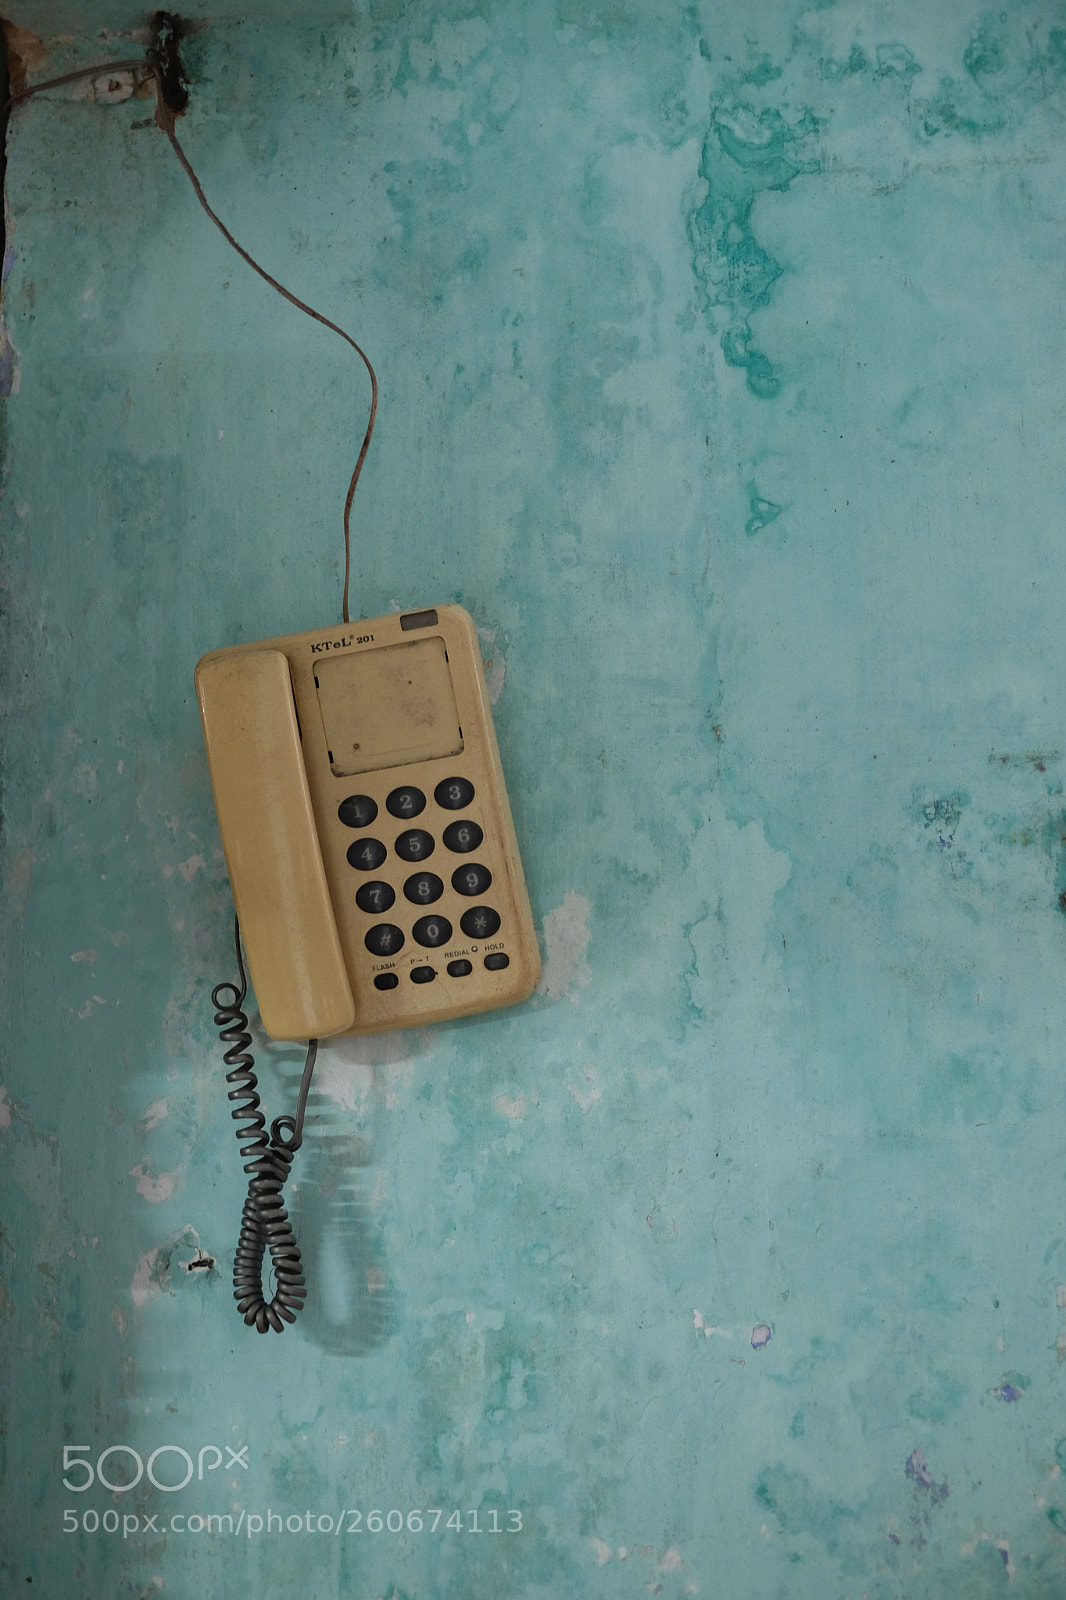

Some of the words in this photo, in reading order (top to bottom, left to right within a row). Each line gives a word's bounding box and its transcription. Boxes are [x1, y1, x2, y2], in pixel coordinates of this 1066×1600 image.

[357, 634, 374, 645] 201
[353, 805, 364, 819] 1
[400, 794, 413, 810] 2
[449, 785, 462, 801] 3
[361, 846, 373, 861] 4
[409, 837, 421, 852] 5
[457, 828, 470, 843] 6
[369, 889, 381, 904] 7
[418, 881, 430, 896] 8
[465, 872, 479, 888] 9
[426, 924, 440, 939] 0
[484, 942, 505, 951] HOLD
[444, 949, 471, 958] REDIAL
[372, 962, 396, 972] FLASH
